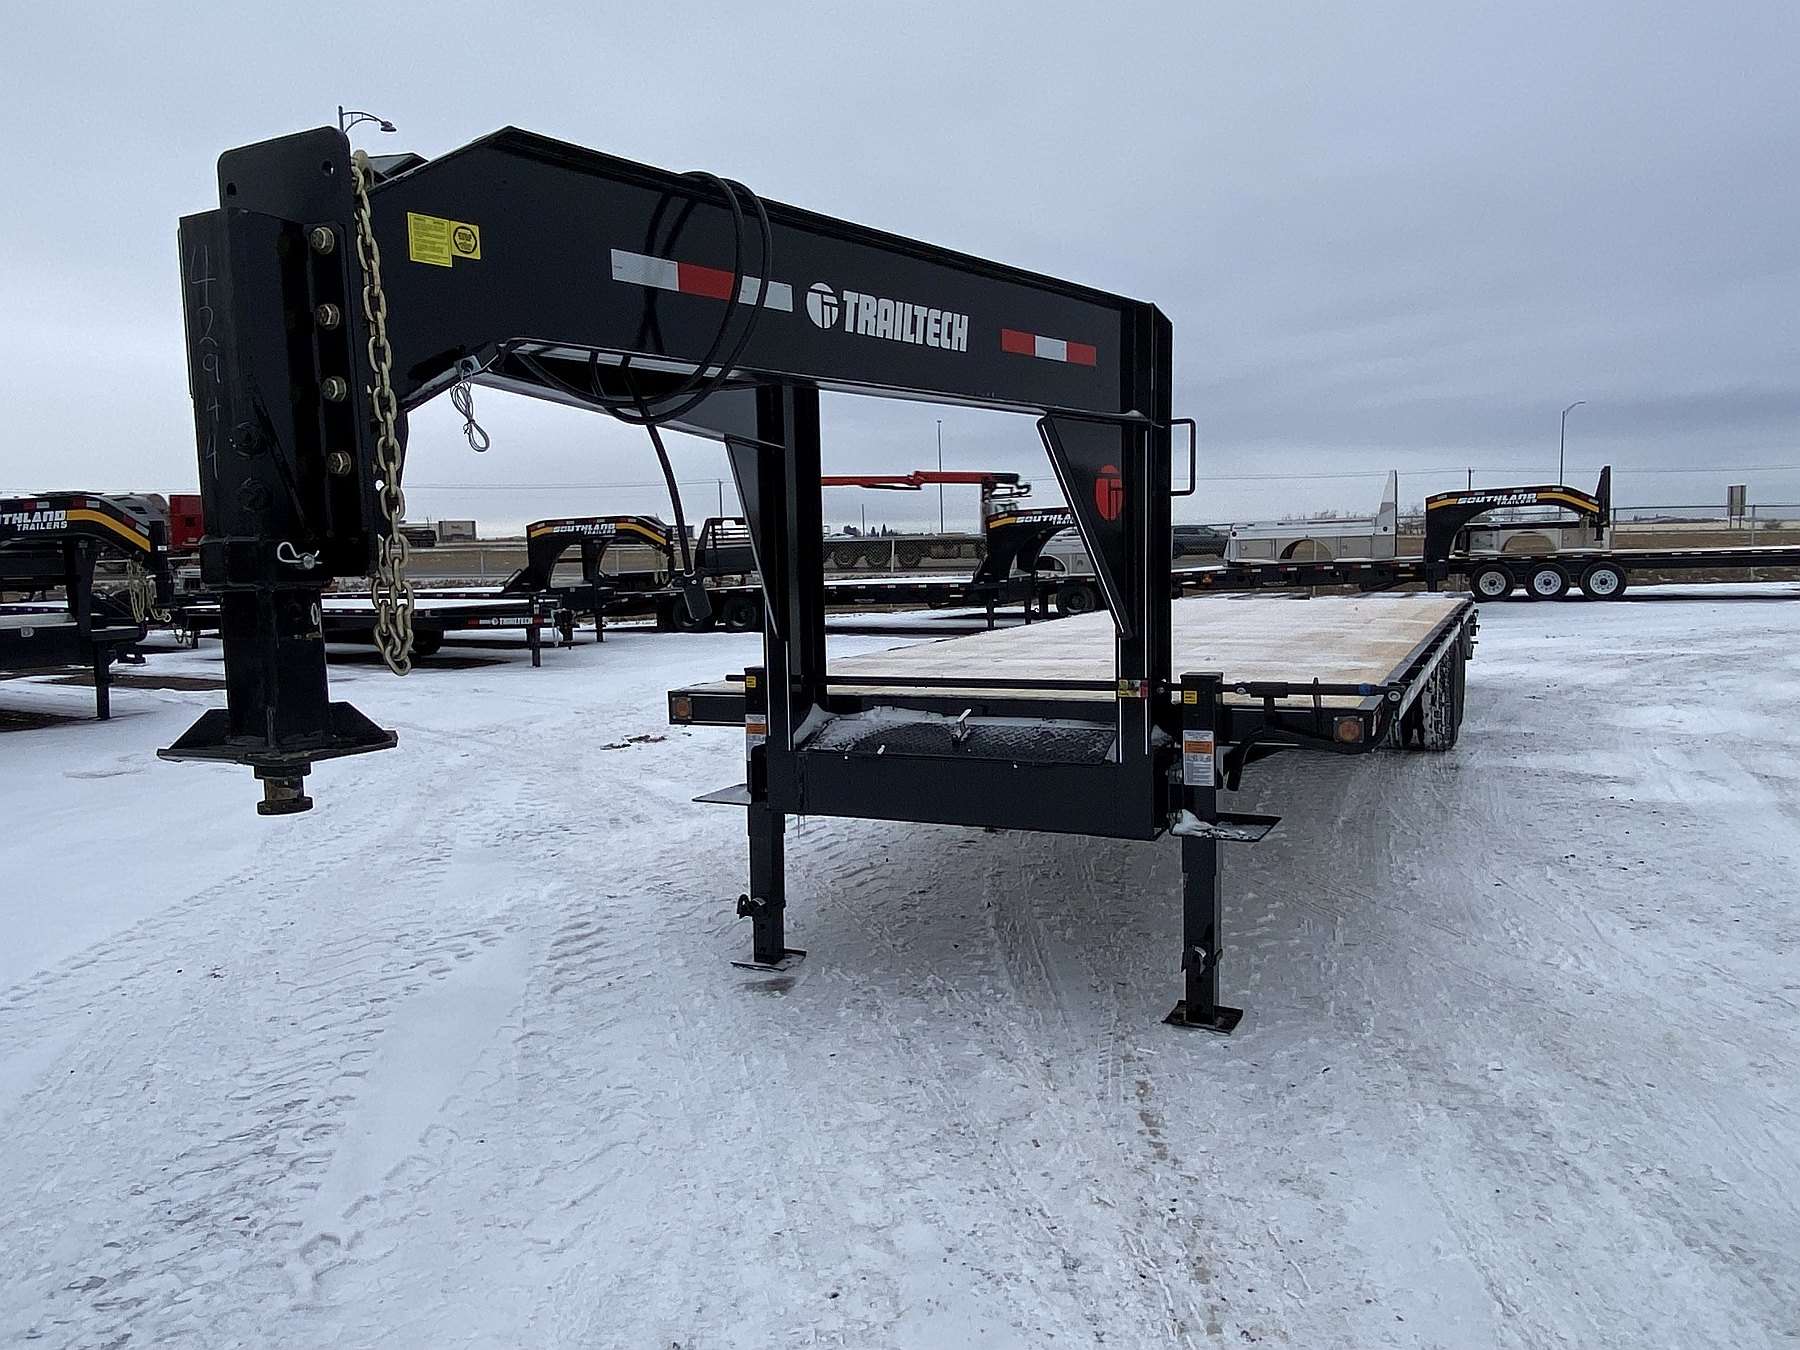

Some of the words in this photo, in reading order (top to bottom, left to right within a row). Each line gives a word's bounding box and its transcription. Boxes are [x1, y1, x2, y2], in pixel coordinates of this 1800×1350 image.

[843, 290, 969, 352] TRAILTECH
[1457, 493, 1537, 504] SOUTHLAND
[0, 510, 66, 525] THLAND
[16, 520, 67, 532] TRAILERS
[553, 523, 616, 533] SOUTHLAND
